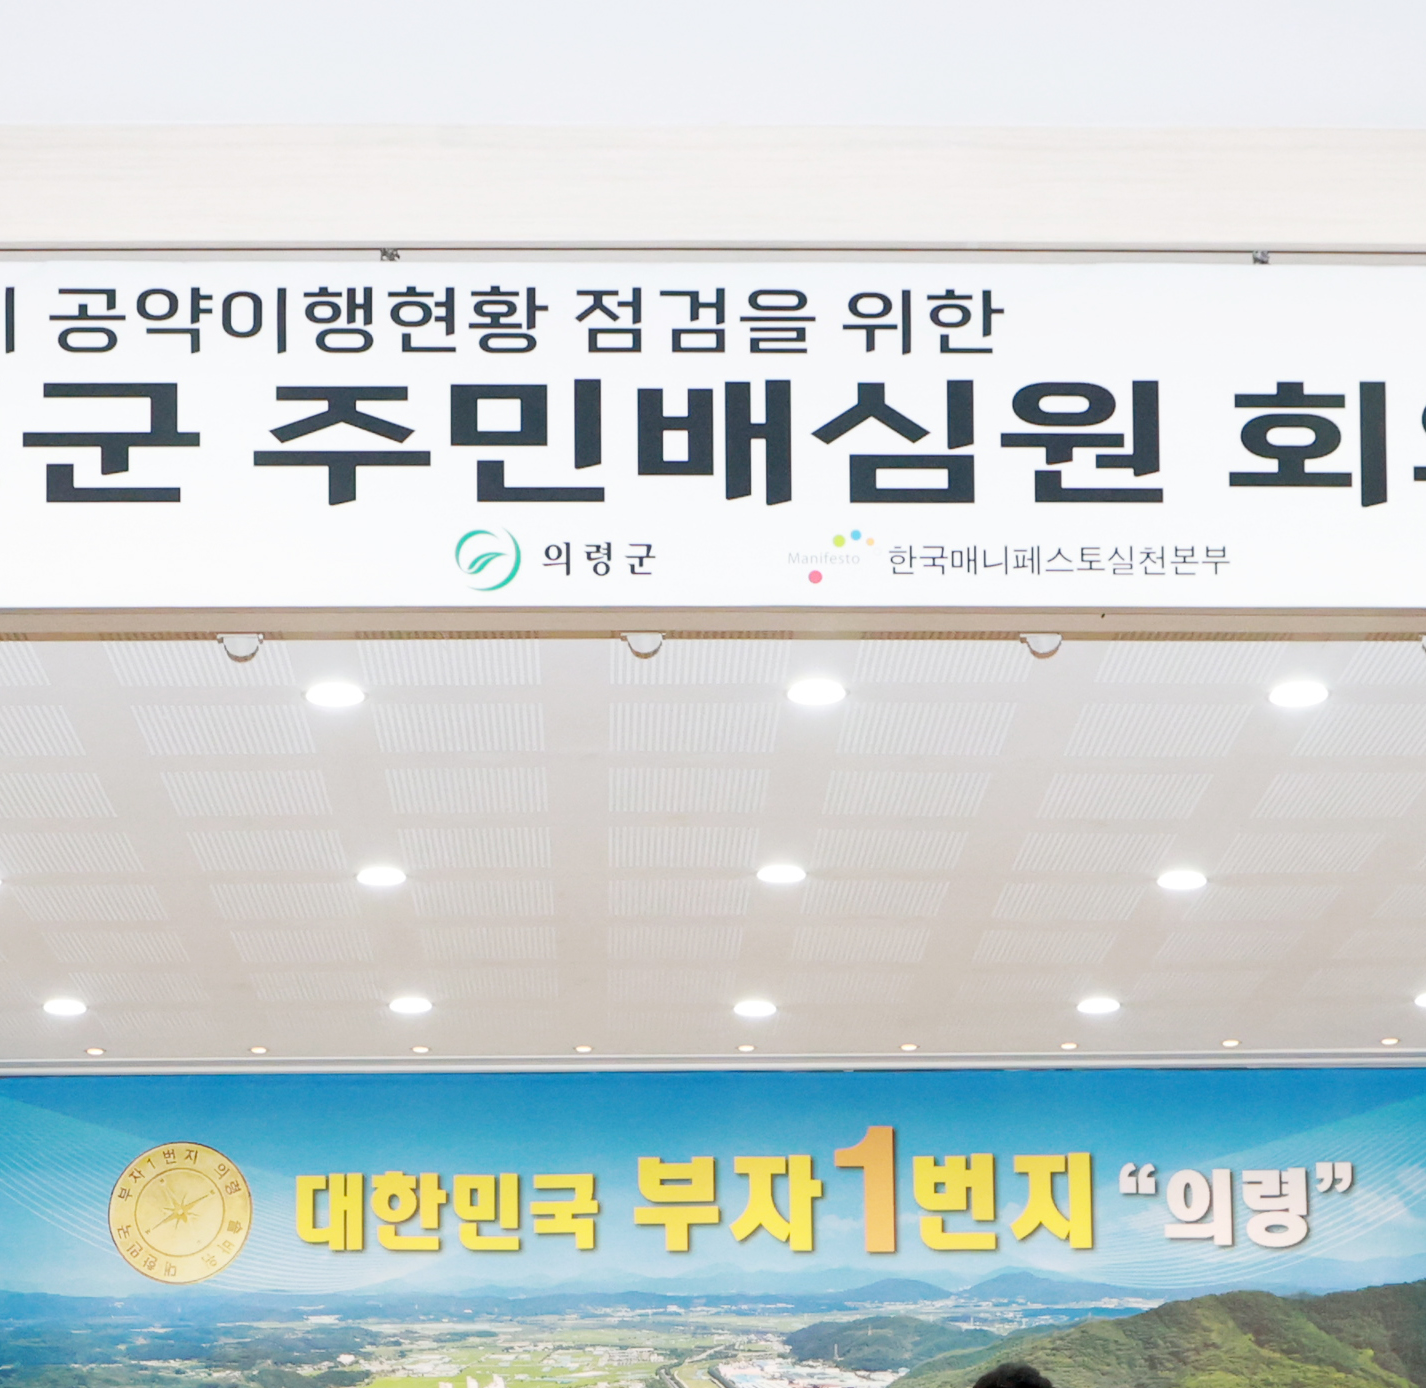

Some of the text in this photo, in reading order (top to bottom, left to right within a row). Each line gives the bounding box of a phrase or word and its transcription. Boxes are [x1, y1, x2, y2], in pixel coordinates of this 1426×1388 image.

[50, 286, 549, 354] 공약이행현황
[576, 288, 816, 353] 점검을
[843, 289, 1004, 355] 위한
[254, 378, 1164, 507] 주민배심원
[542, 541, 656, 576] 의령군
[787, 551, 860, 565] Manifesto
[889, 545, 1230, 575] 한국매니페스토실천본부
[117, 1148, 199, 1202] 부자1번지
[295, 1171, 599, 1253] 대한민국
[633, 1125, 1094, 1253] 부자1번지
